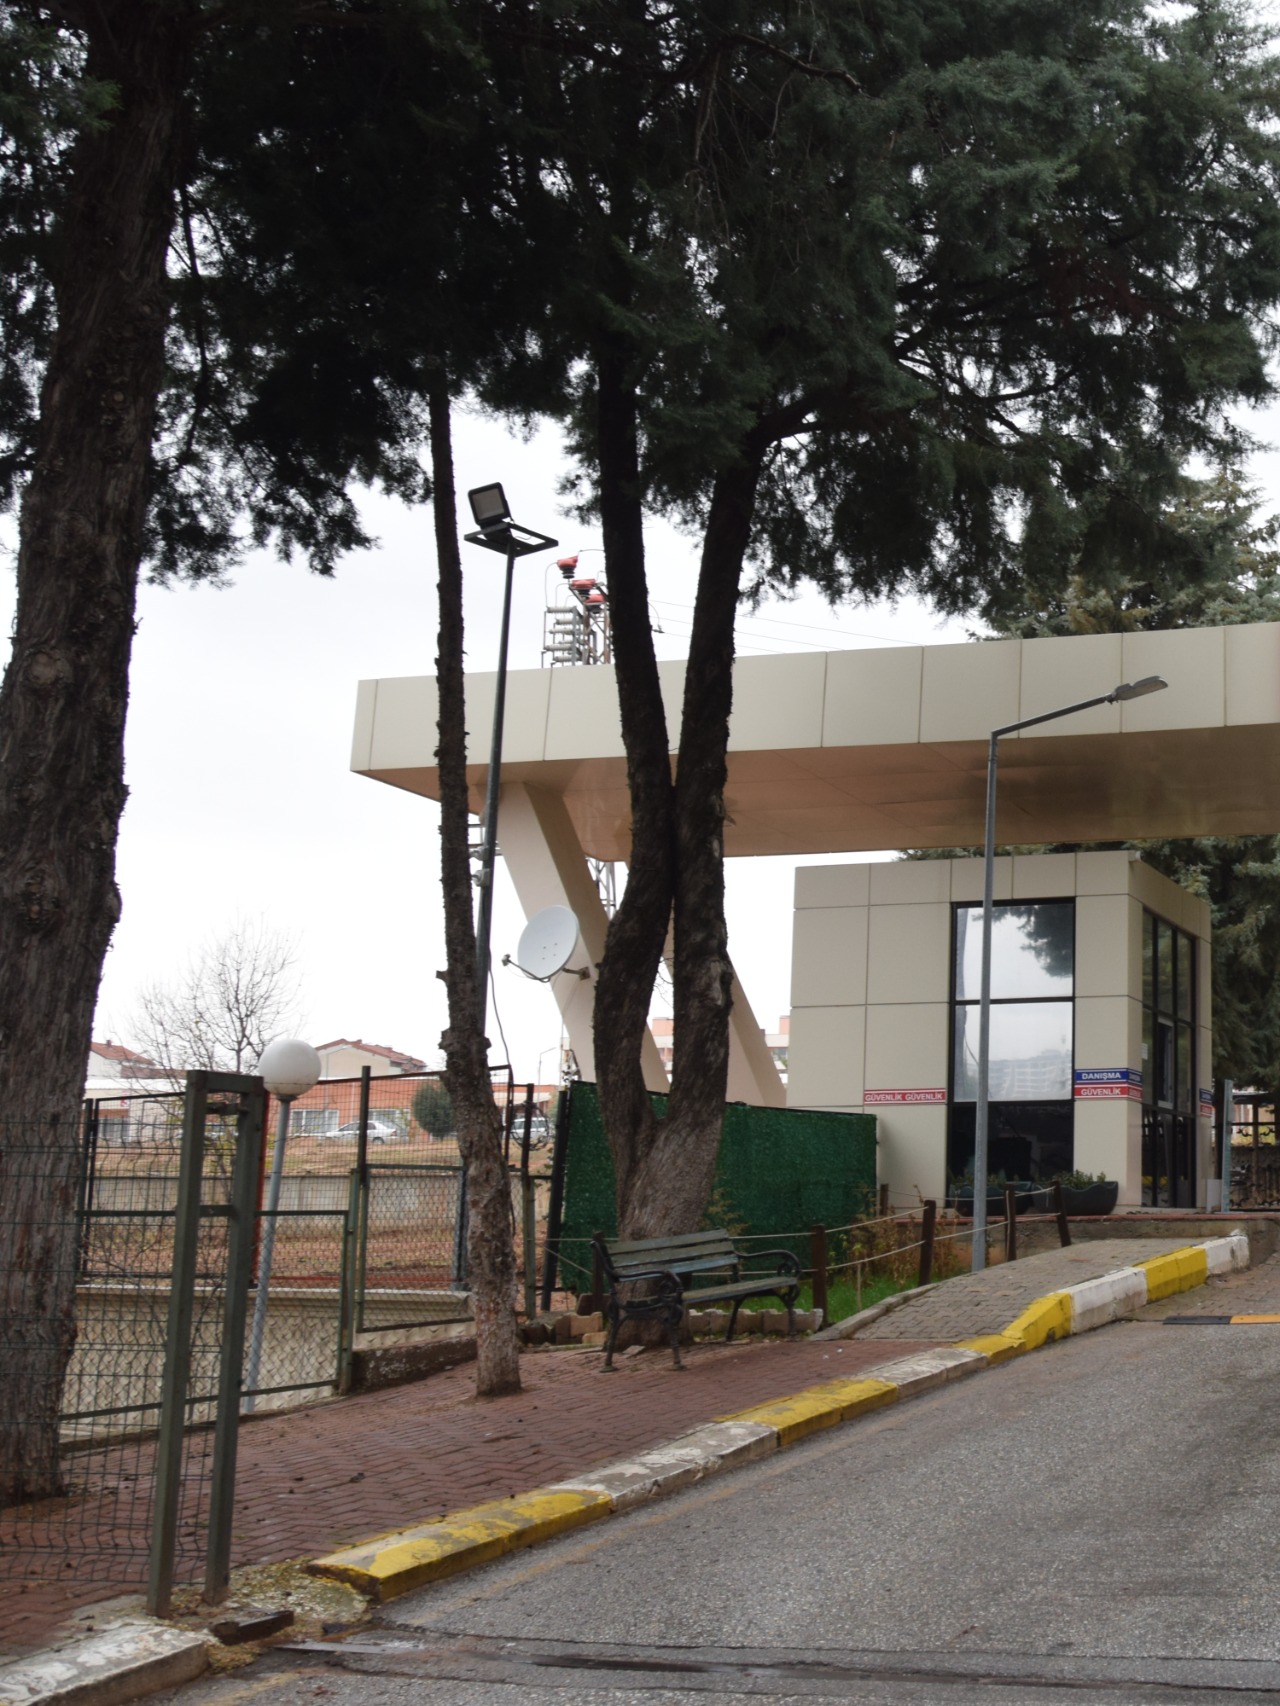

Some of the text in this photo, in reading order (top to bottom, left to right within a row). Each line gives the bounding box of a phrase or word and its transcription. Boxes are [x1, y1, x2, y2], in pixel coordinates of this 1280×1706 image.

[1081, 1072, 1122, 1081] DANIŞMA
[1080, 1087, 1122, 1096] GÜVENLİK
[865, 1092, 943, 1102] GÜVENLİK GÜVENLİK
